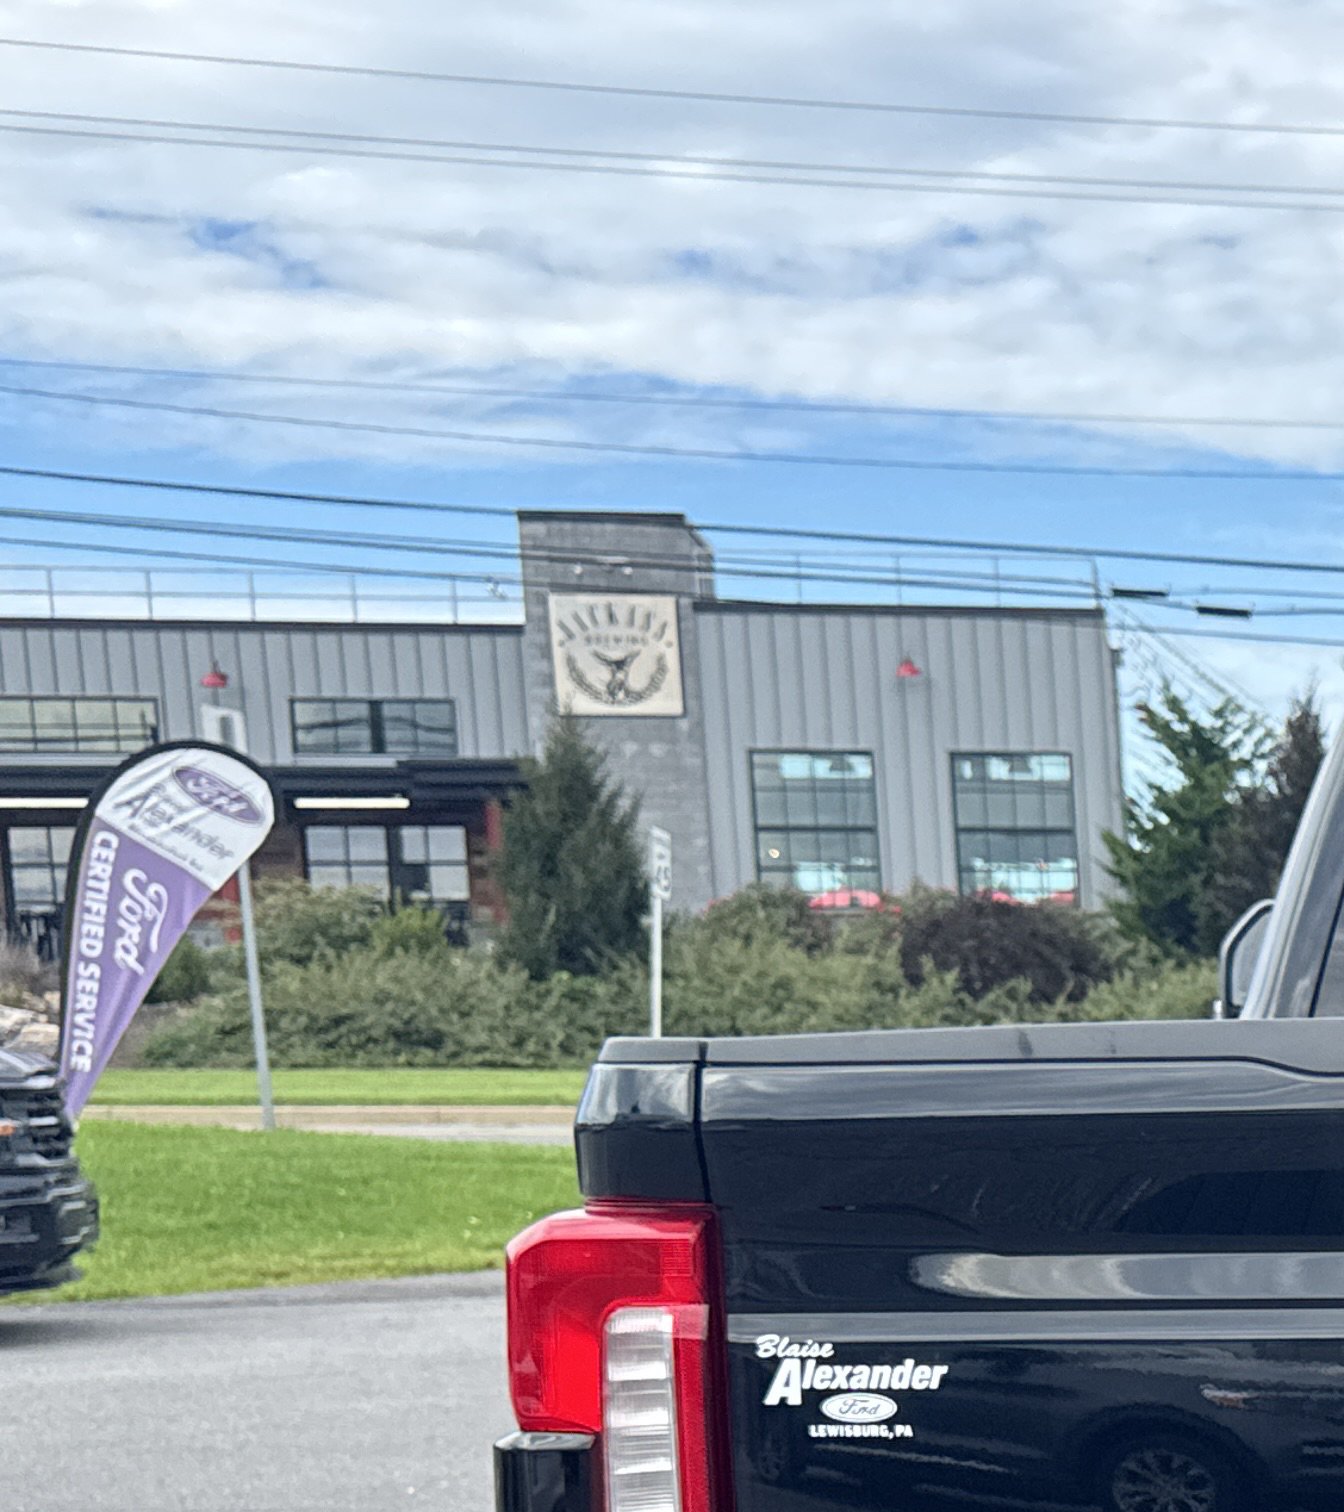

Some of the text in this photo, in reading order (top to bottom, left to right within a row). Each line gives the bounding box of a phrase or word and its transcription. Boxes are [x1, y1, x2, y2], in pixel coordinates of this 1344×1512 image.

[113, 867, 169, 976] Ford
[70, 830, 120, 1074] CERTIFIED SERVICE
[756, 1334, 835, 1358] Blaise
[762, 1357, 949, 1406] Alexander
[838, 1398, 882, 1416] Ford
[807, 1424, 913, 1440] LEWISBURG, PA
